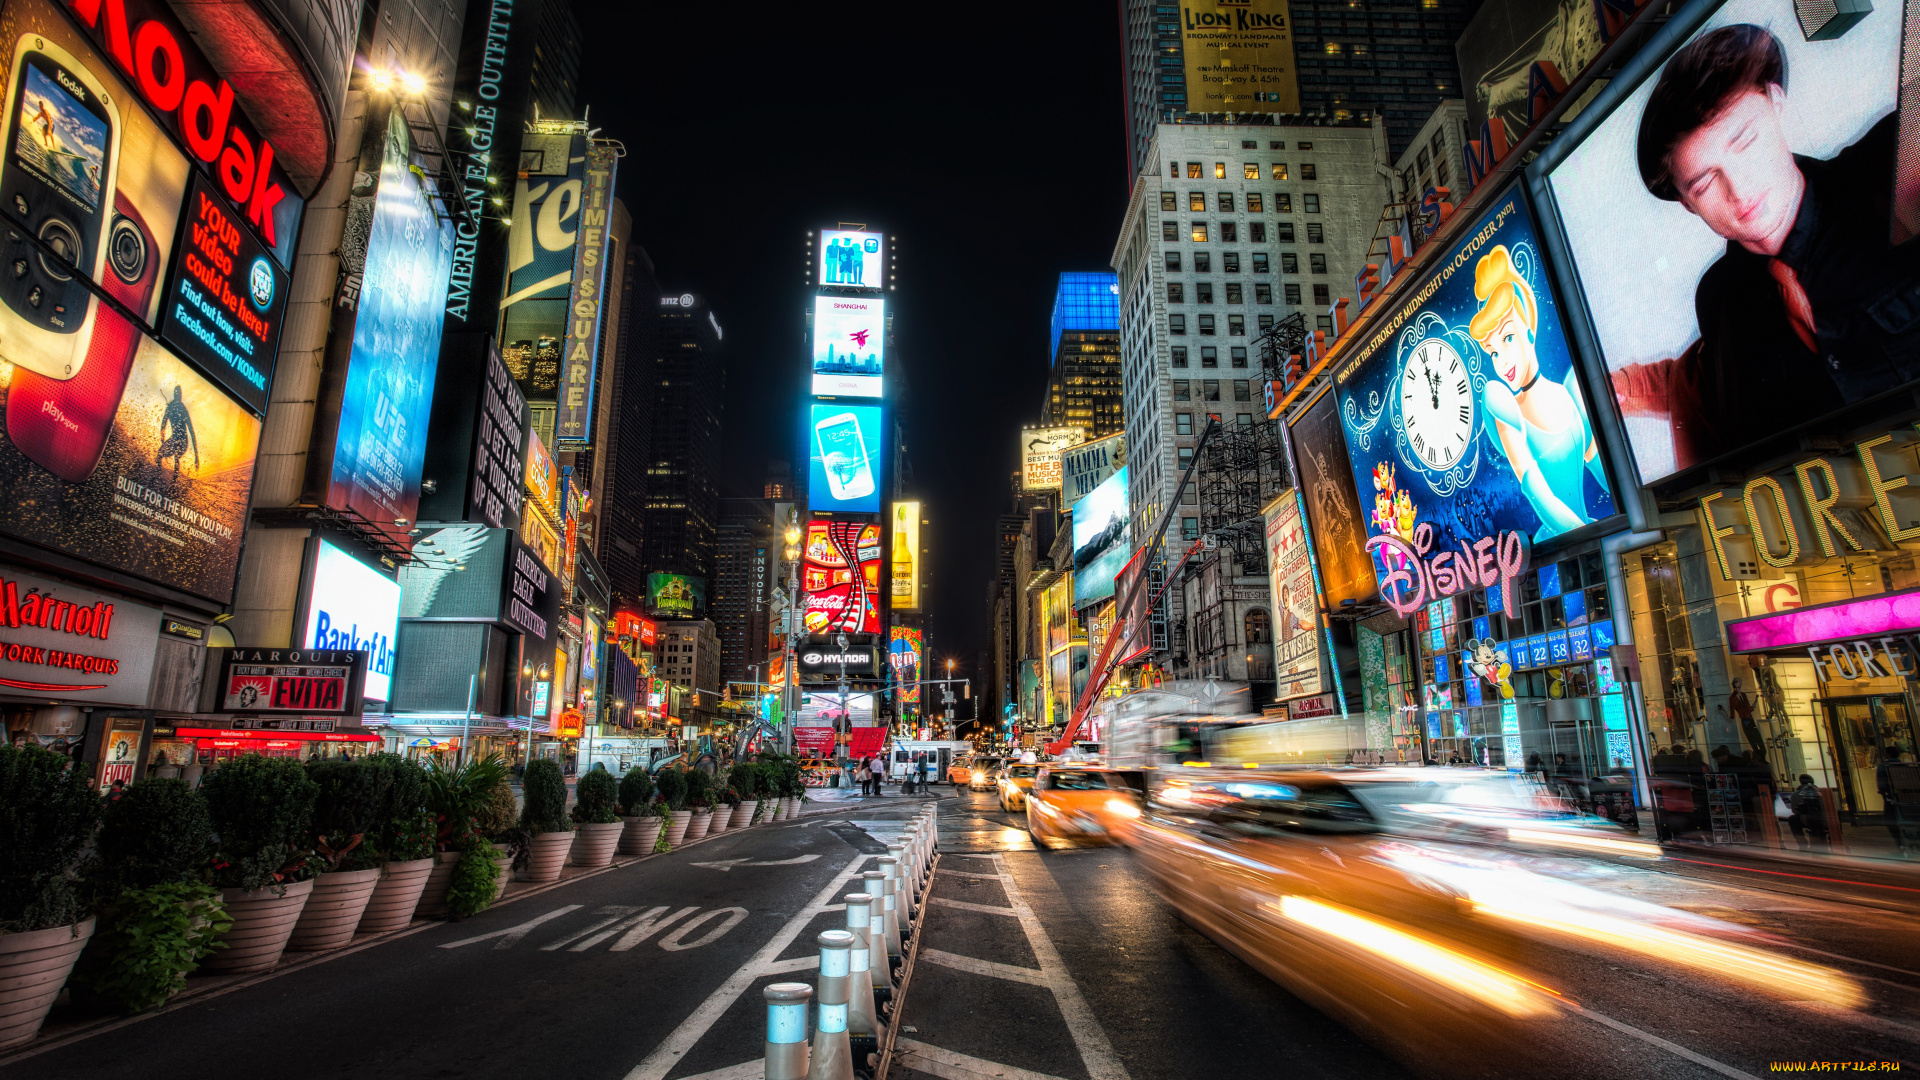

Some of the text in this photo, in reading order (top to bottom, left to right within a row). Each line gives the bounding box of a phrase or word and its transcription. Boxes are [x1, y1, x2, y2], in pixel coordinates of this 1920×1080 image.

[1185, 8, 1285, 30] LION KING
[57, 69, 86, 102] Kodak
[1203, 75, 1280, 85] Broadway & 45th
[1213, 64, 1284, 73] Minskoff Theatre
[1206, 92, 1252, 101] lionking.com
[465, 105, 497, 183] EAGLE
[200, 191, 241, 257] YOUR
[193, 222, 232, 276] video
[446, 176, 487, 321] AMERICAN
[186, 252, 223, 297] could
[221, 281, 238, 313] be
[237, 297, 270, 343] here!
[567, 170, 609, 407] TIMES SQUARE
[833, 302, 868, 311] SHANGHAI
[1337, 367, 1351, 384] OWN
[1360, 342, 1373, 362] THE
[1370, 317, 1394, 351] STROKE
[1392, 304, 1405, 328] OF
[1404, 273, 1443, 319] MIDNIGHT
[1442, 262, 1456, 281] ON
[1454, 219, 1499, 268] OCTOBER
[181, 278, 254, 356] Find out how, visit:
[489, 348, 524, 426] STOP BACK
[42, 400, 78, 432] play sport
[374, 391, 406, 448] UFC
[487, 379, 523, 454] TOMORROW
[482, 411, 522, 486] TO GET A PIC
[535, 447, 543, 466] WE
[1027, 455, 1046, 463] BEST
[1066, 447, 1108, 477] MAMMA
[474, 475, 486, 509] UP
[477, 443, 521, 518] OF YOUR FACE
[531, 463, 550, 500] COMEDY
[1028, 477, 1045, 485] THIS
[116, 475, 233, 540] BUILT FOR THE WAY YOU PLAY.
[513, 570, 534, 606] EAGLE
[515, 547, 548, 594] AMERICAN
[756, 557, 765, 612] NOVOTEL
[314, 609, 360, 651] Bank
[511, 597, 547, 640] OUTFITTERS
[47, 649, 119, 675] MARQUIS
[231, 650, 354, 662] MARQUIS
[823, 654, 869, 662] HYUNDAI
[1517, 640, 1589, 664] 11 22 58 32
[273, 678, 338, 709] EVITA
[102, 764, 134, 786] EVITA
